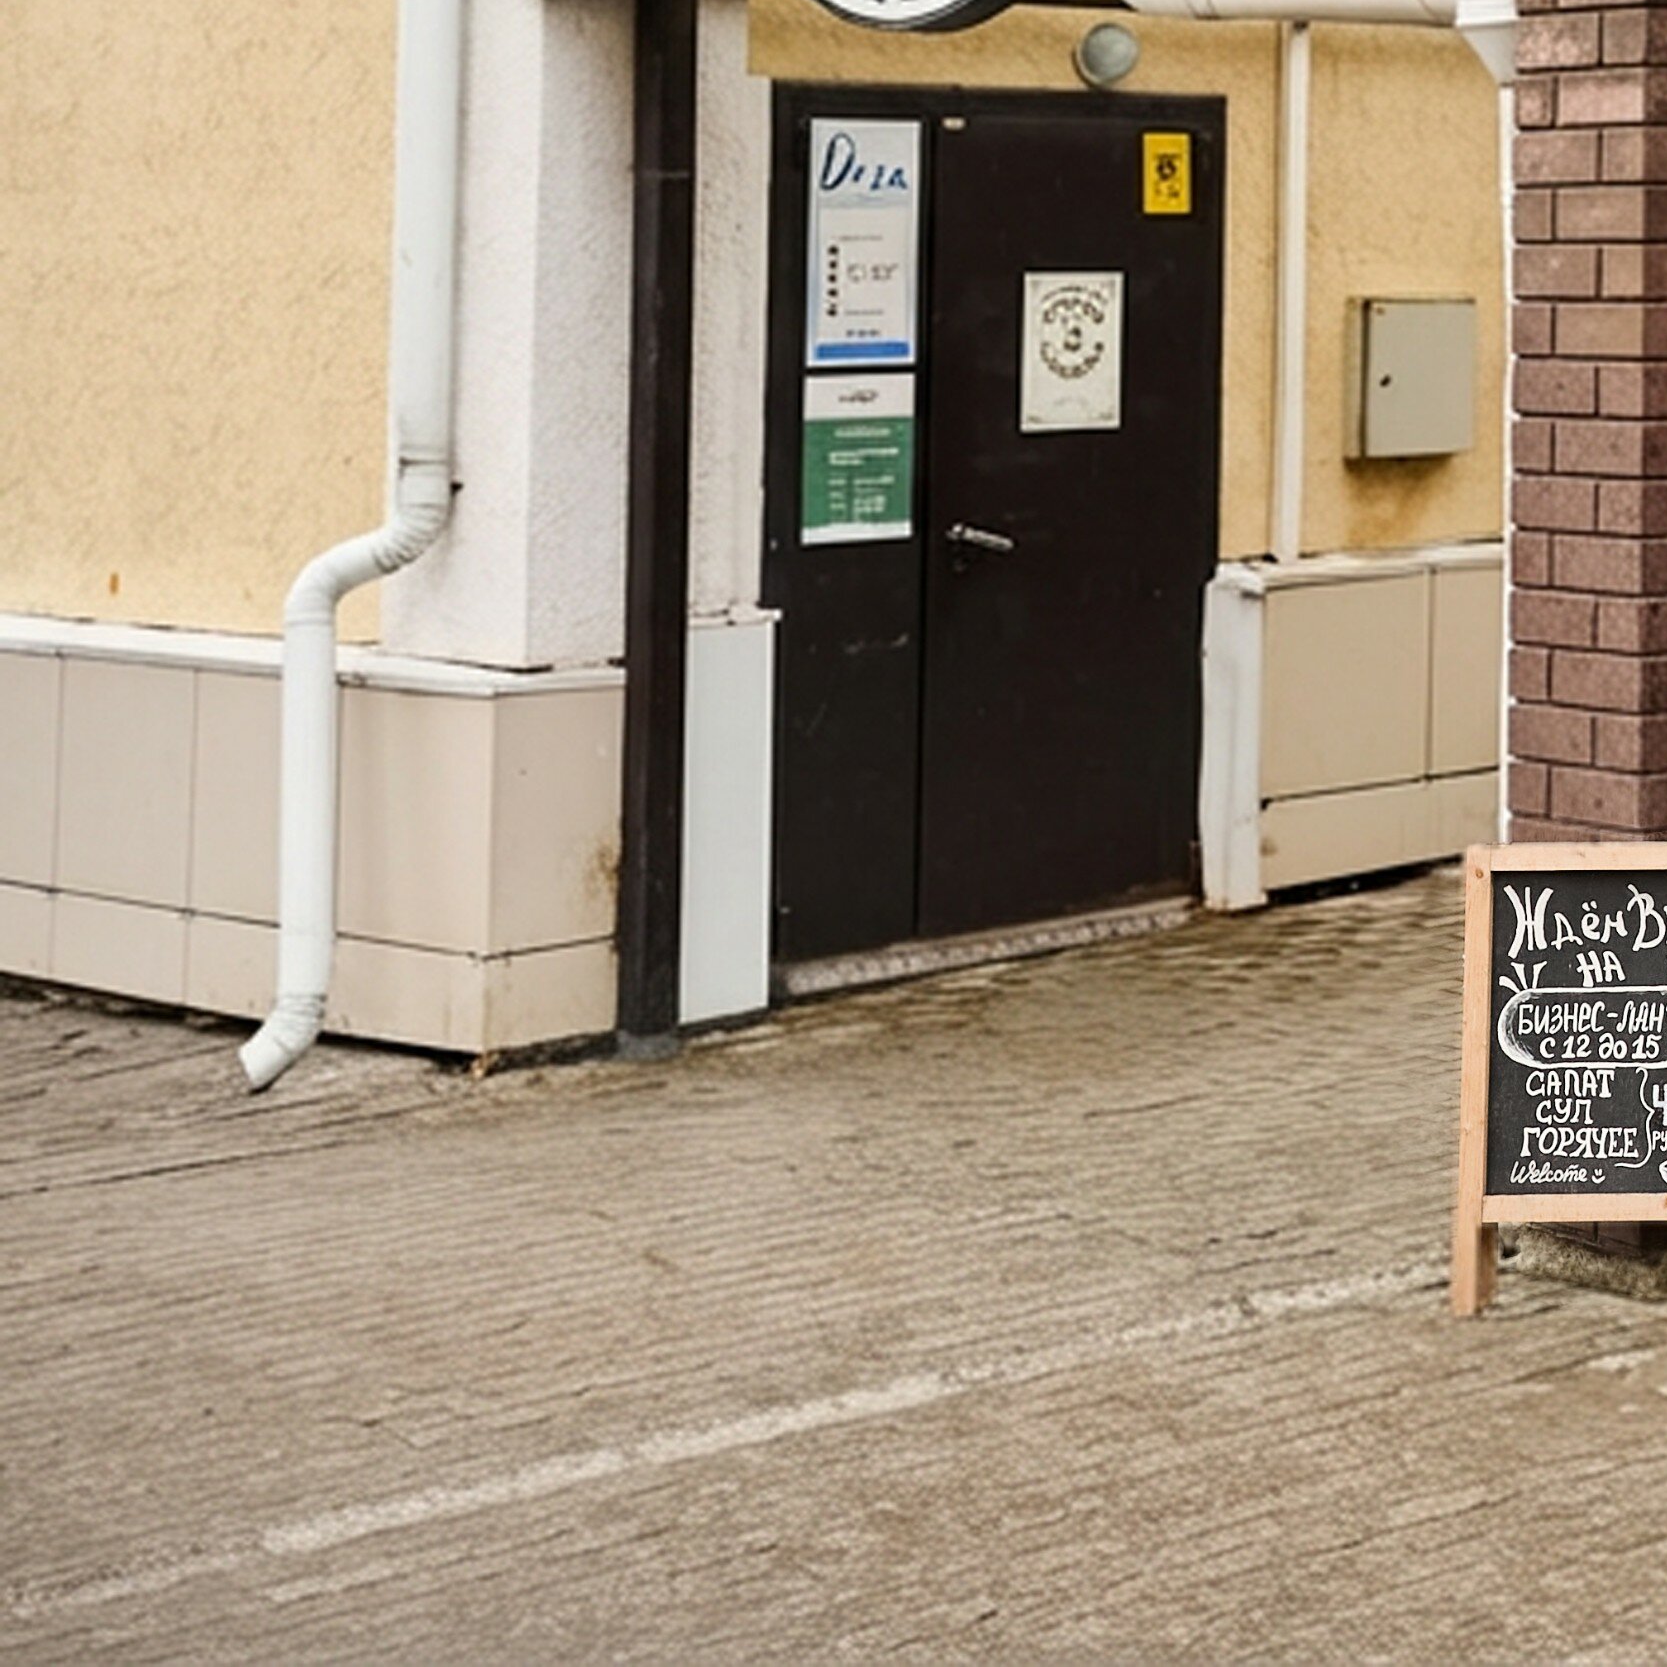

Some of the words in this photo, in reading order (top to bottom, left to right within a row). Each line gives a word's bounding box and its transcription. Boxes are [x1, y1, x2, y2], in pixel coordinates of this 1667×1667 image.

[1576, 950, 1626, 987] НА
[1561, 1035, 1592, 1059] 12
[1598, 1032, 1628, 1059] до
[1631, 1035, 1662, 1059] 15
[1535, 1098, 1594, 1125] СУП
[1519, 1126, 1640, 1159] ГОРЯЧЕЕ
[1509, 1160, 1588, 1184] Welcome
